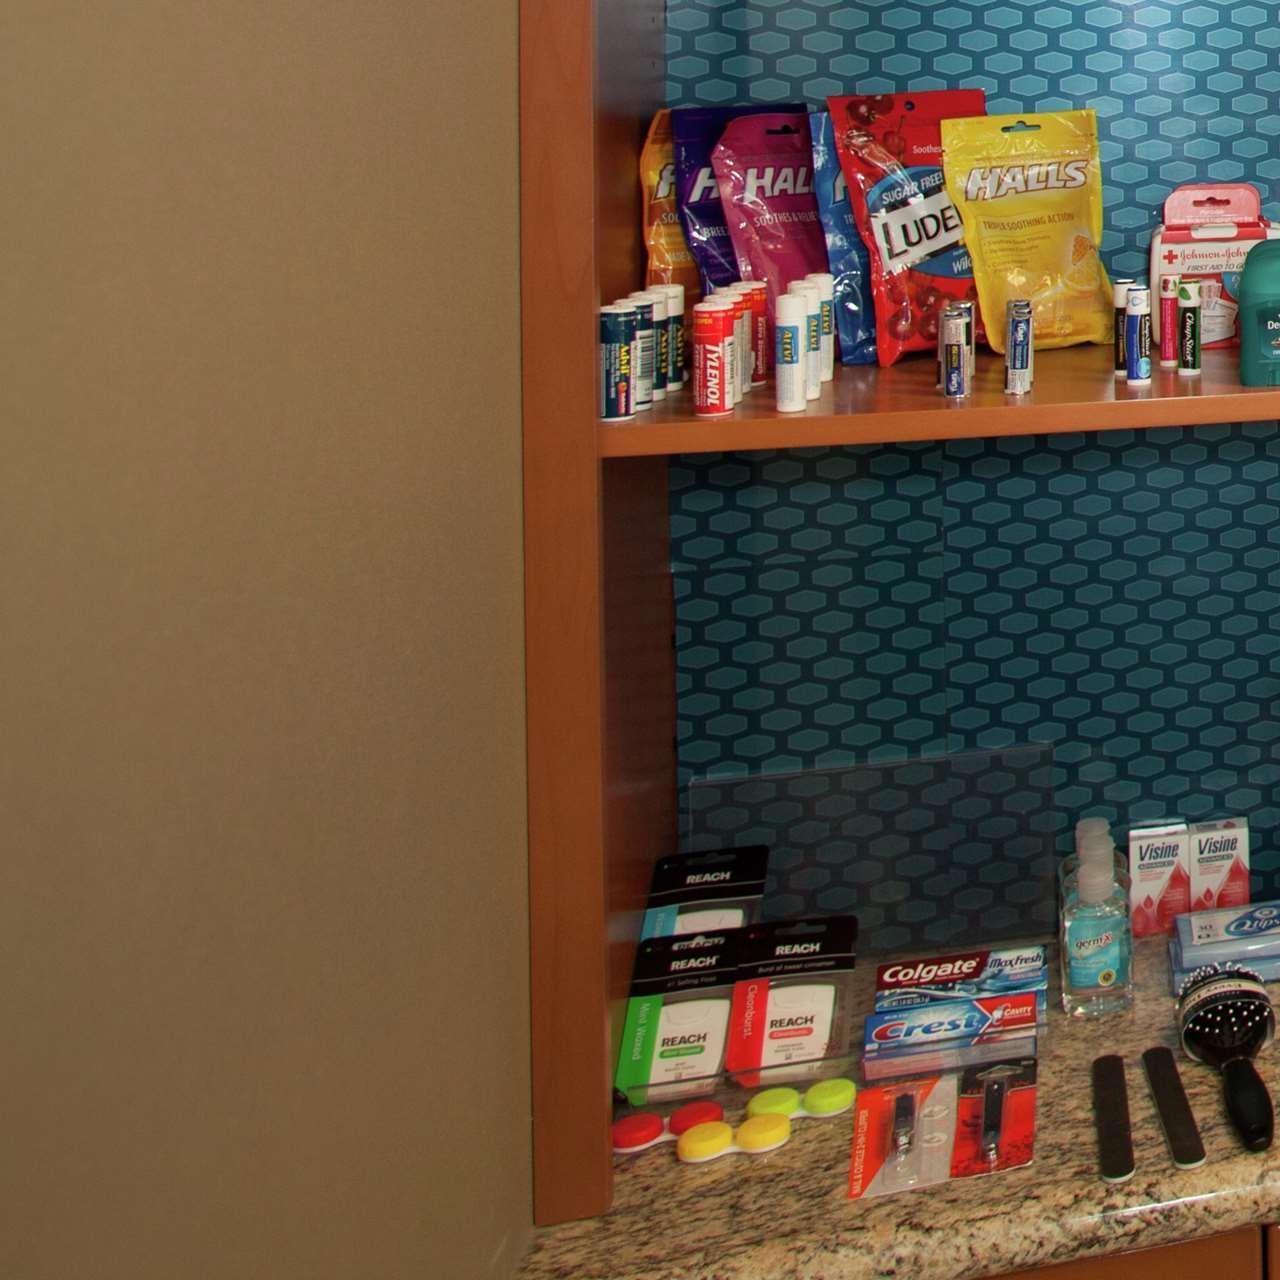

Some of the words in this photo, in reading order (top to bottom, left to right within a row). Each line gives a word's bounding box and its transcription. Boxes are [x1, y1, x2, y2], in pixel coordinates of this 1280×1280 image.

[965, 159, 1091, 202] HALLS
[882, 180, 920, 204] SUGAR
[1185, 312, 1195, 363] ChapStick
[706, 343, 721, 407] TYLENOL
[1138, 841, 1179, 862] Visine
[1198, 835, 1239, 856] Visine
[686, 871, 732, 886] REACH
[775, 942, 821, 956] REACH
[670, 956, 718, 972] REACH
[883, 958, 977, 984] Colgate
[1005, 1005, 1033, 1018] CAVITY
[769, 1015, 815, 1030] REACH
[872, 1012, 980, 1044] Crest
[661, 1033, 708, 1048] REACH
